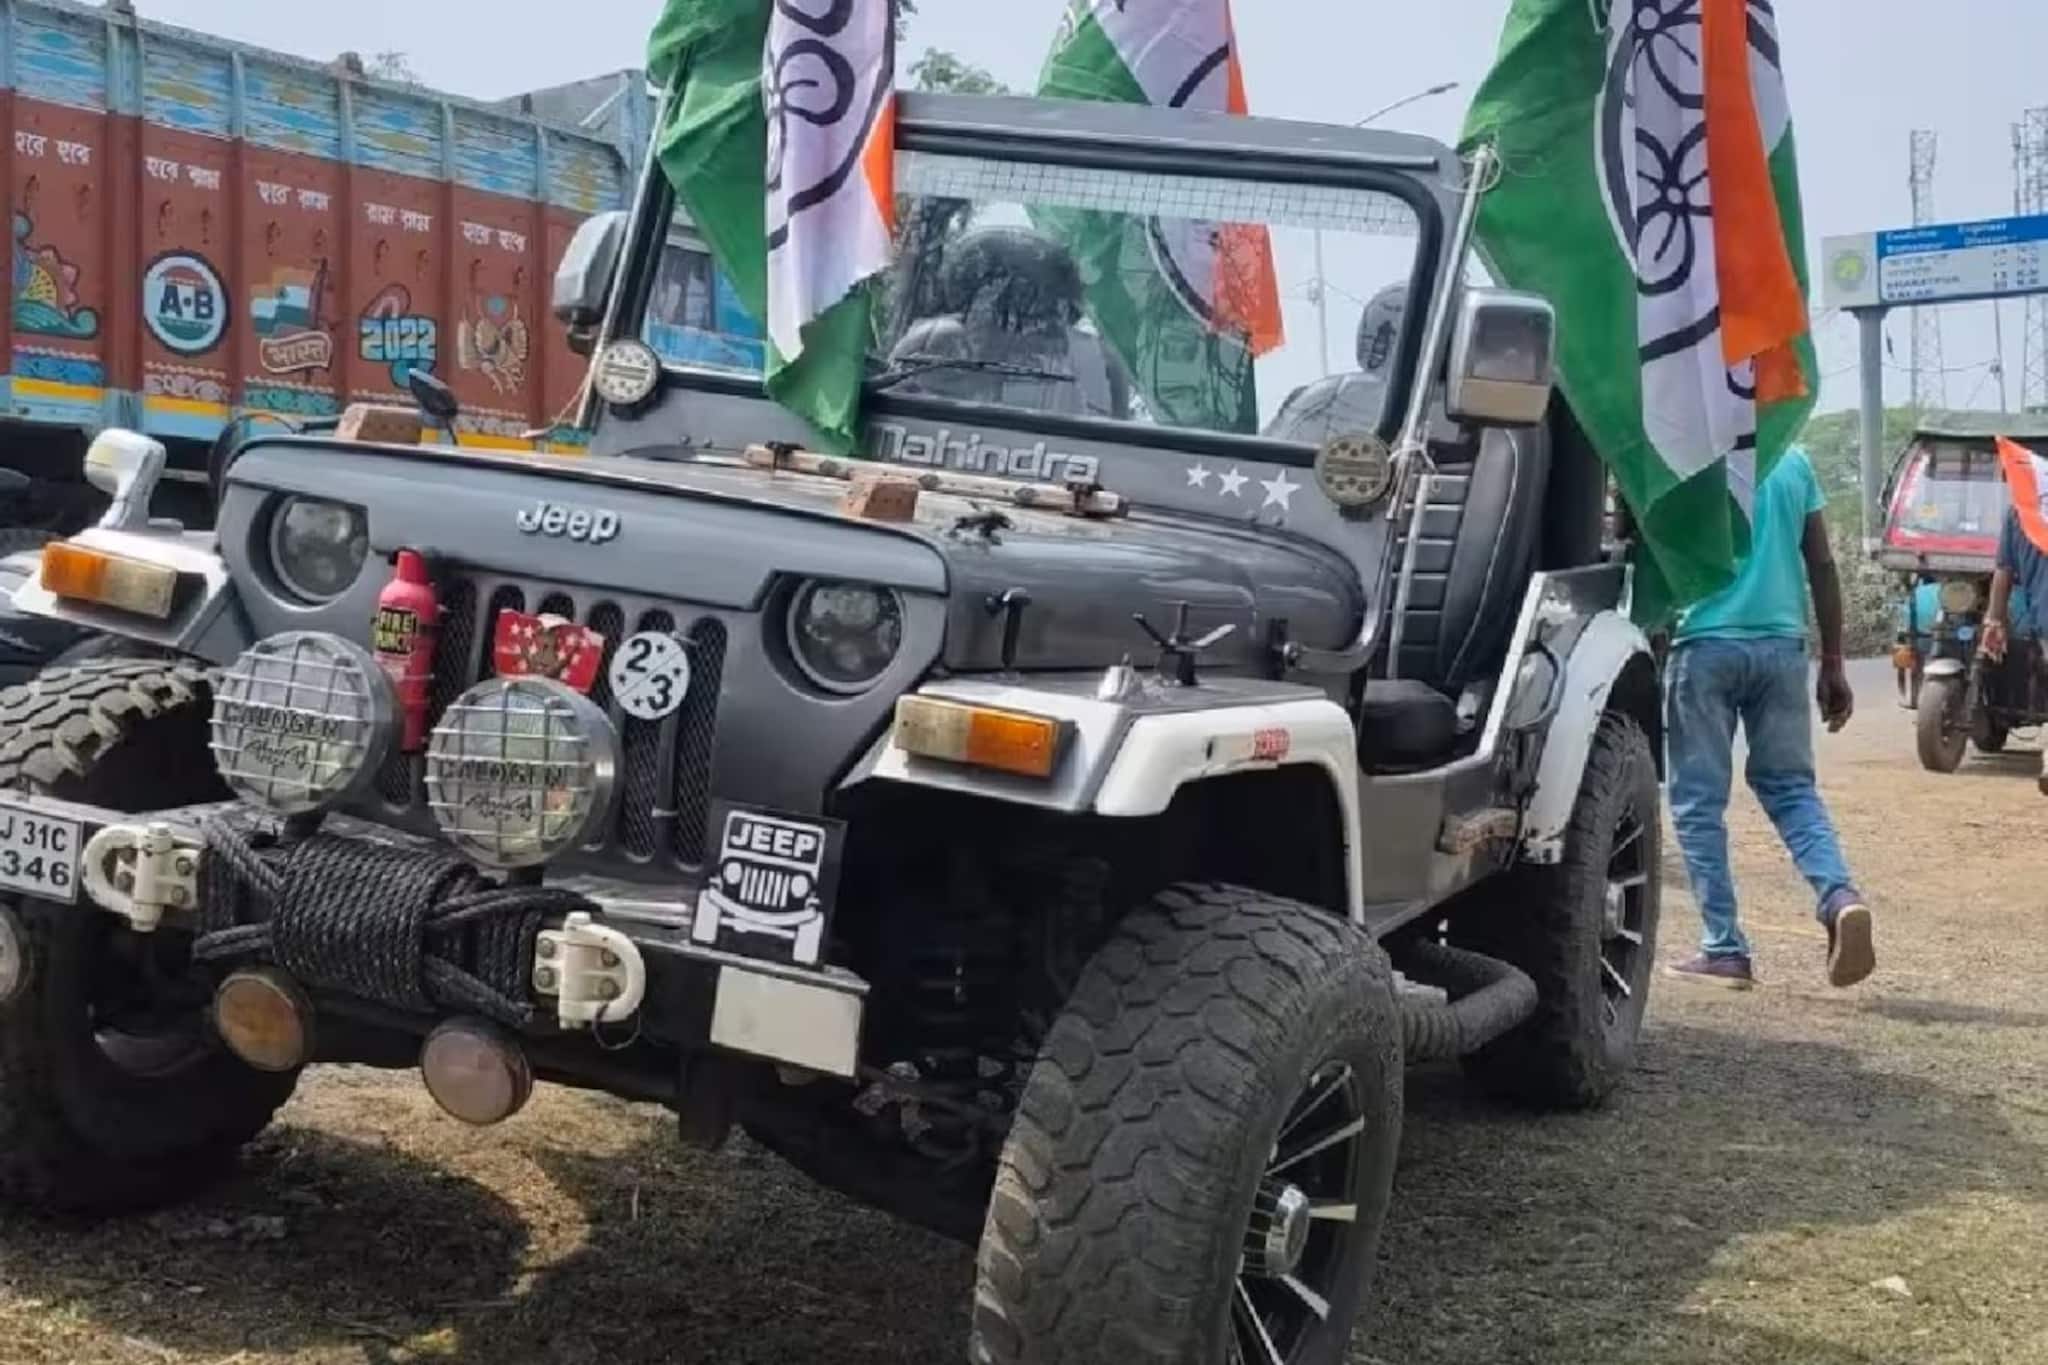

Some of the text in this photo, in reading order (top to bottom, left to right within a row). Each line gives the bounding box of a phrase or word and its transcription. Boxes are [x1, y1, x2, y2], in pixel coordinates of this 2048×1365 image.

[360, 317, 437, 360] 2022
[516, 500, 622, 545] Jeep
[729, 822, 818, 858] JEEP
